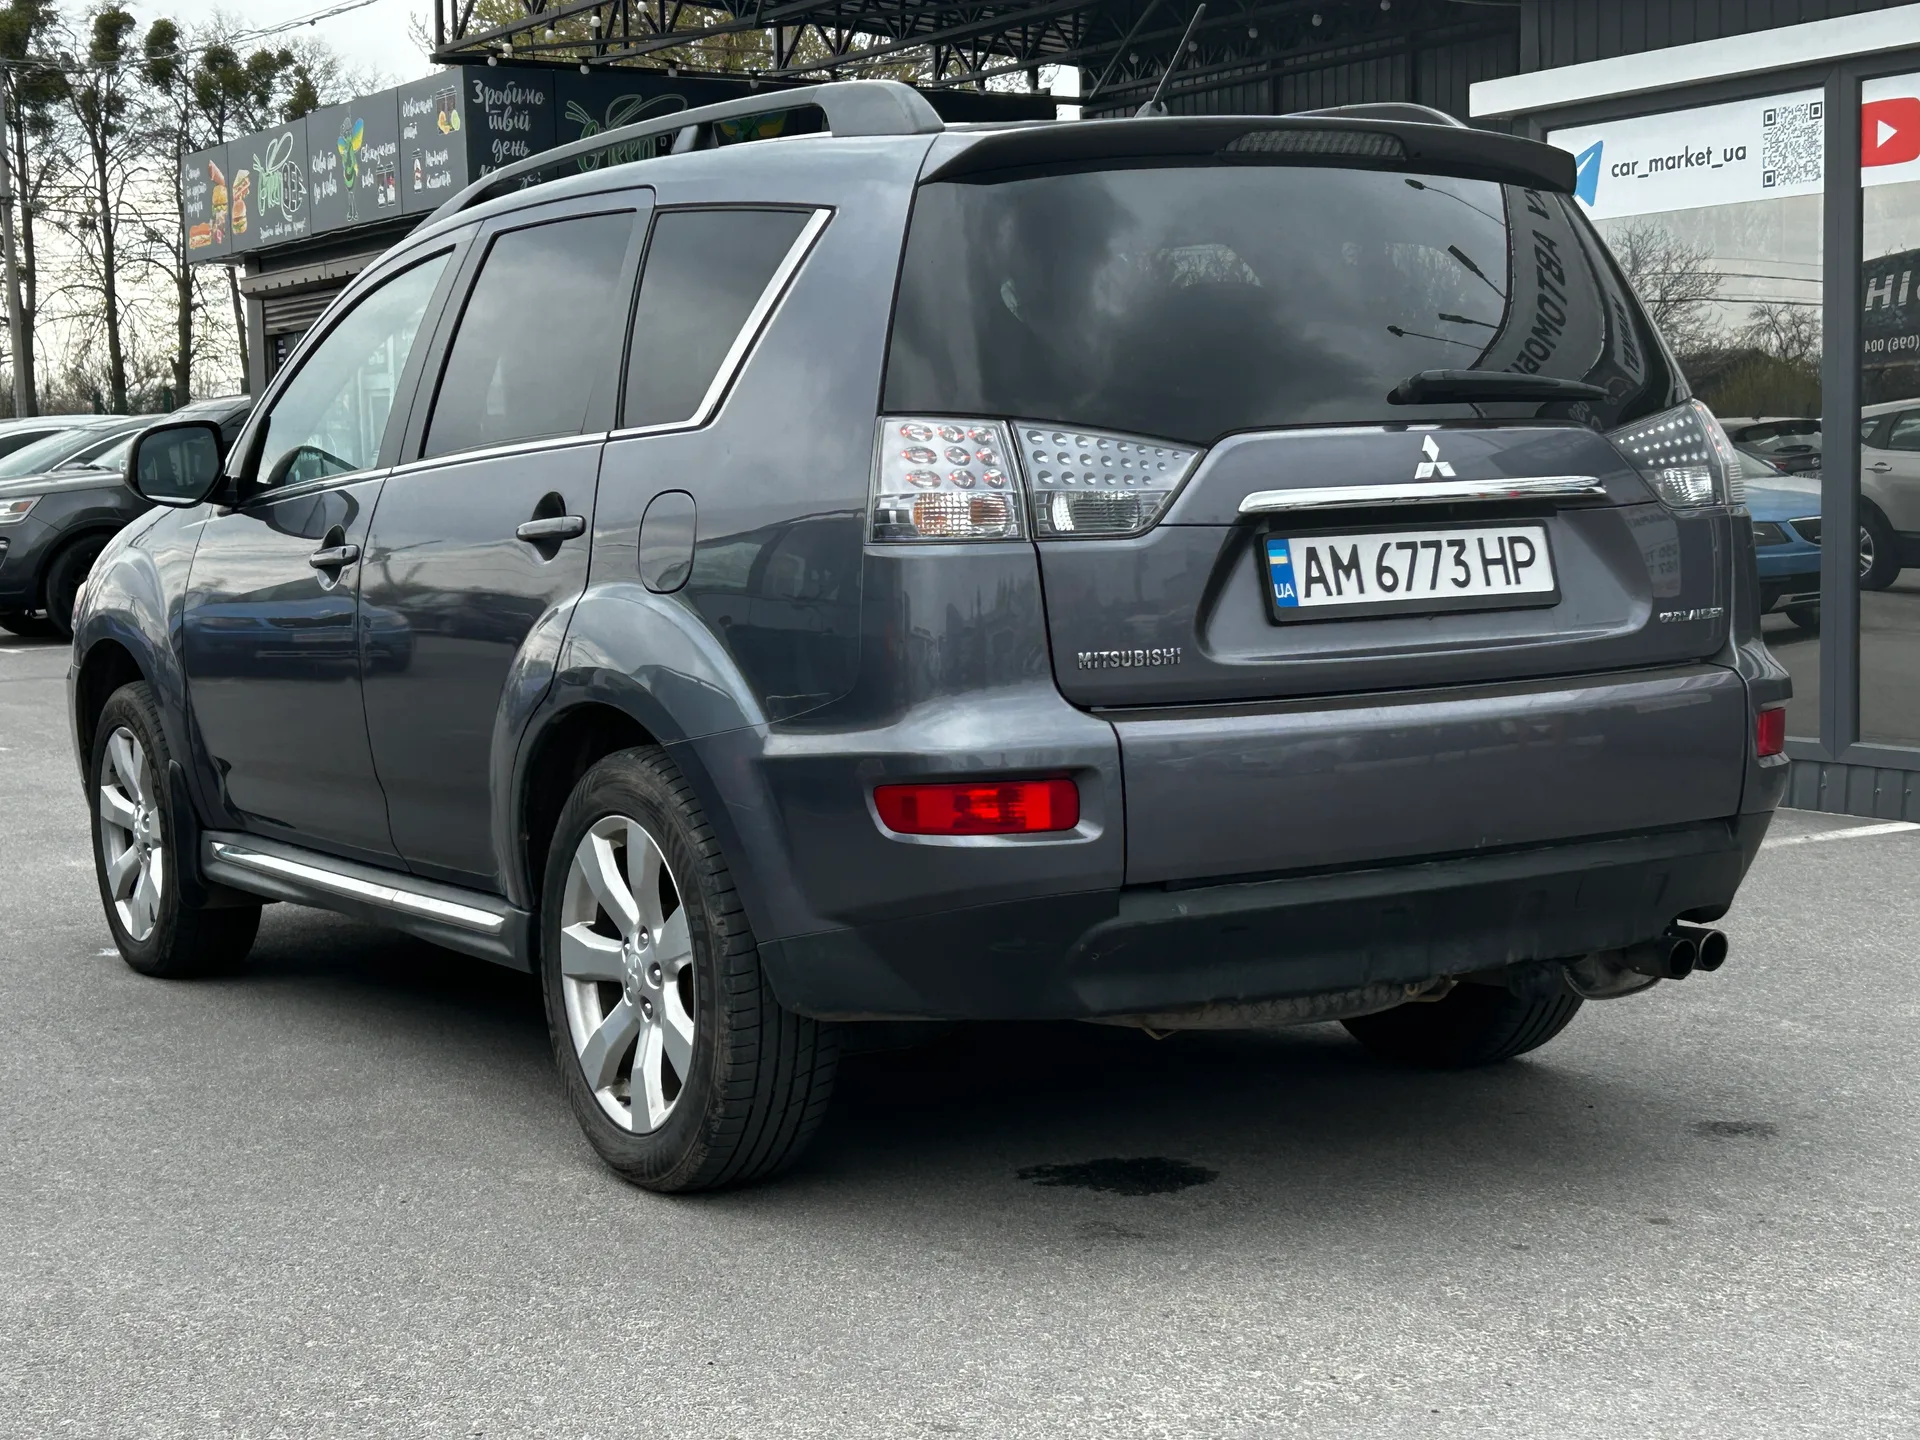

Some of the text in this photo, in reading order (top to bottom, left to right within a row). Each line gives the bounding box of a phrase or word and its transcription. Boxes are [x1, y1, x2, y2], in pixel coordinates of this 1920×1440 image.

[472, 79, 546, 113] Зробимо
[488, 105, 531, 132] твій
[491, 138, 531, 163] день
[1611, 145, 1747, 178] car_market_ua
[1303, 535, 1536, 598] AM 6773 HP
[1274, 583, 1295, 599] UA
[1077, 648, 1182, 670] MITSUBISHI
